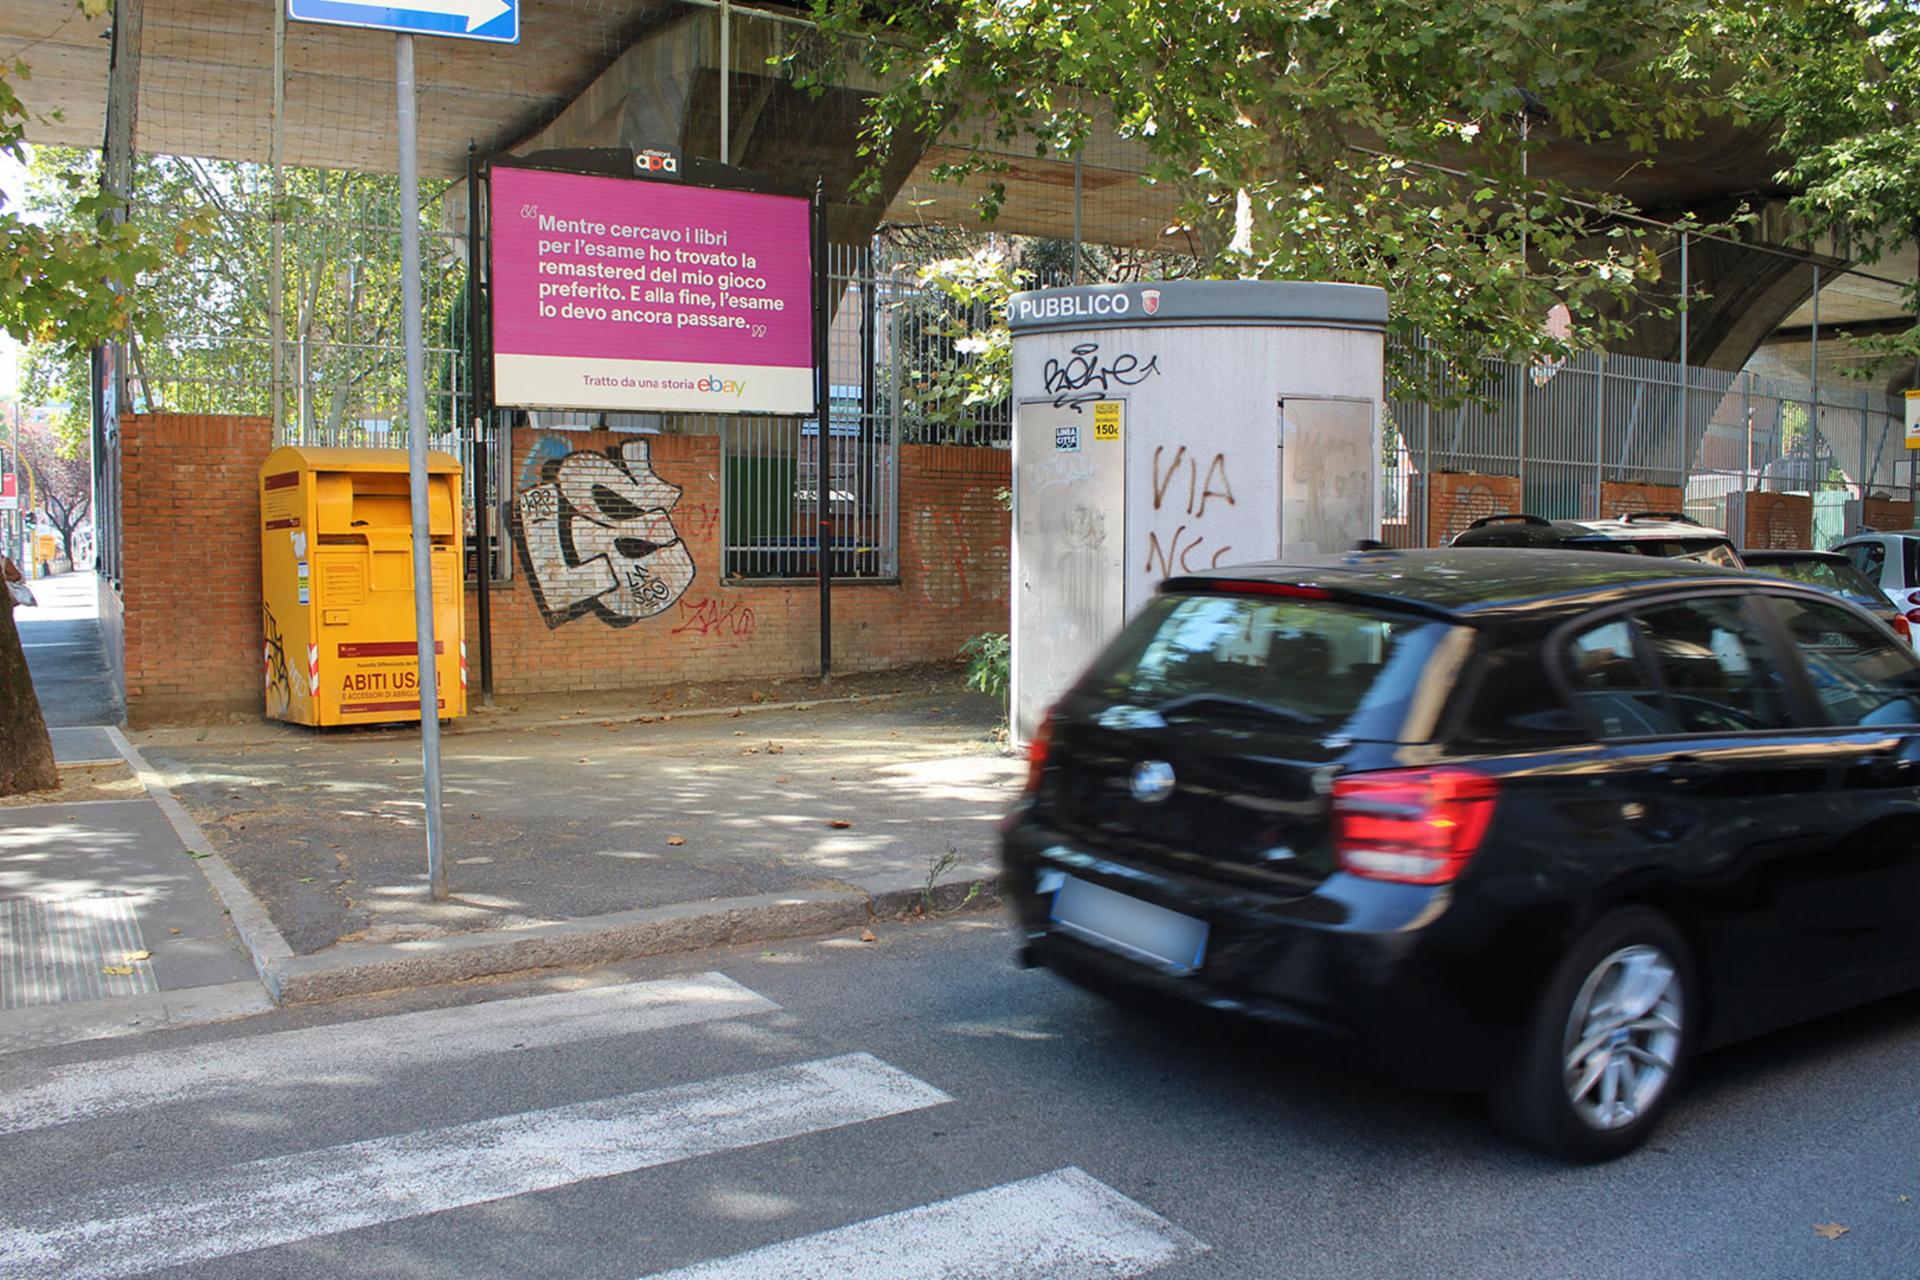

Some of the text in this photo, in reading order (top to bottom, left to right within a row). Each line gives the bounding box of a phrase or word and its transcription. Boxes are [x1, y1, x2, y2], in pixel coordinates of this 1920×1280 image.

[636, 154, 677, 172] apa
[610, 225, 681, 243] cercavo
[685, 227, 690, 243] i
[694, 228, 728, 246] libri
[538, 239, 572, 256] per
[649, 244, 672, 262] ho
[675, 247, 738, 268] trovato
[741, 252, 757, 269] la
[538, 260, 767, 289] remastered del mio gioco
[538, 280, 627, 301] preferito.
[630, 285, 641, 302] E
[644, 286, 675, 304] alla
[678, 288, 717, 309] fine,
[1020, 293, 1130, 319] PUBBLICO
[539, 300, 557, 318] lo
[560, 301, 608, 321] devo
[610, 308, 673, 325] ancora
[583, 374, 746, 397] Tratto da una storia ebay
[1153, 445, 1235, 518] VIA
[342, 671, 441, 691] ABITI USI
